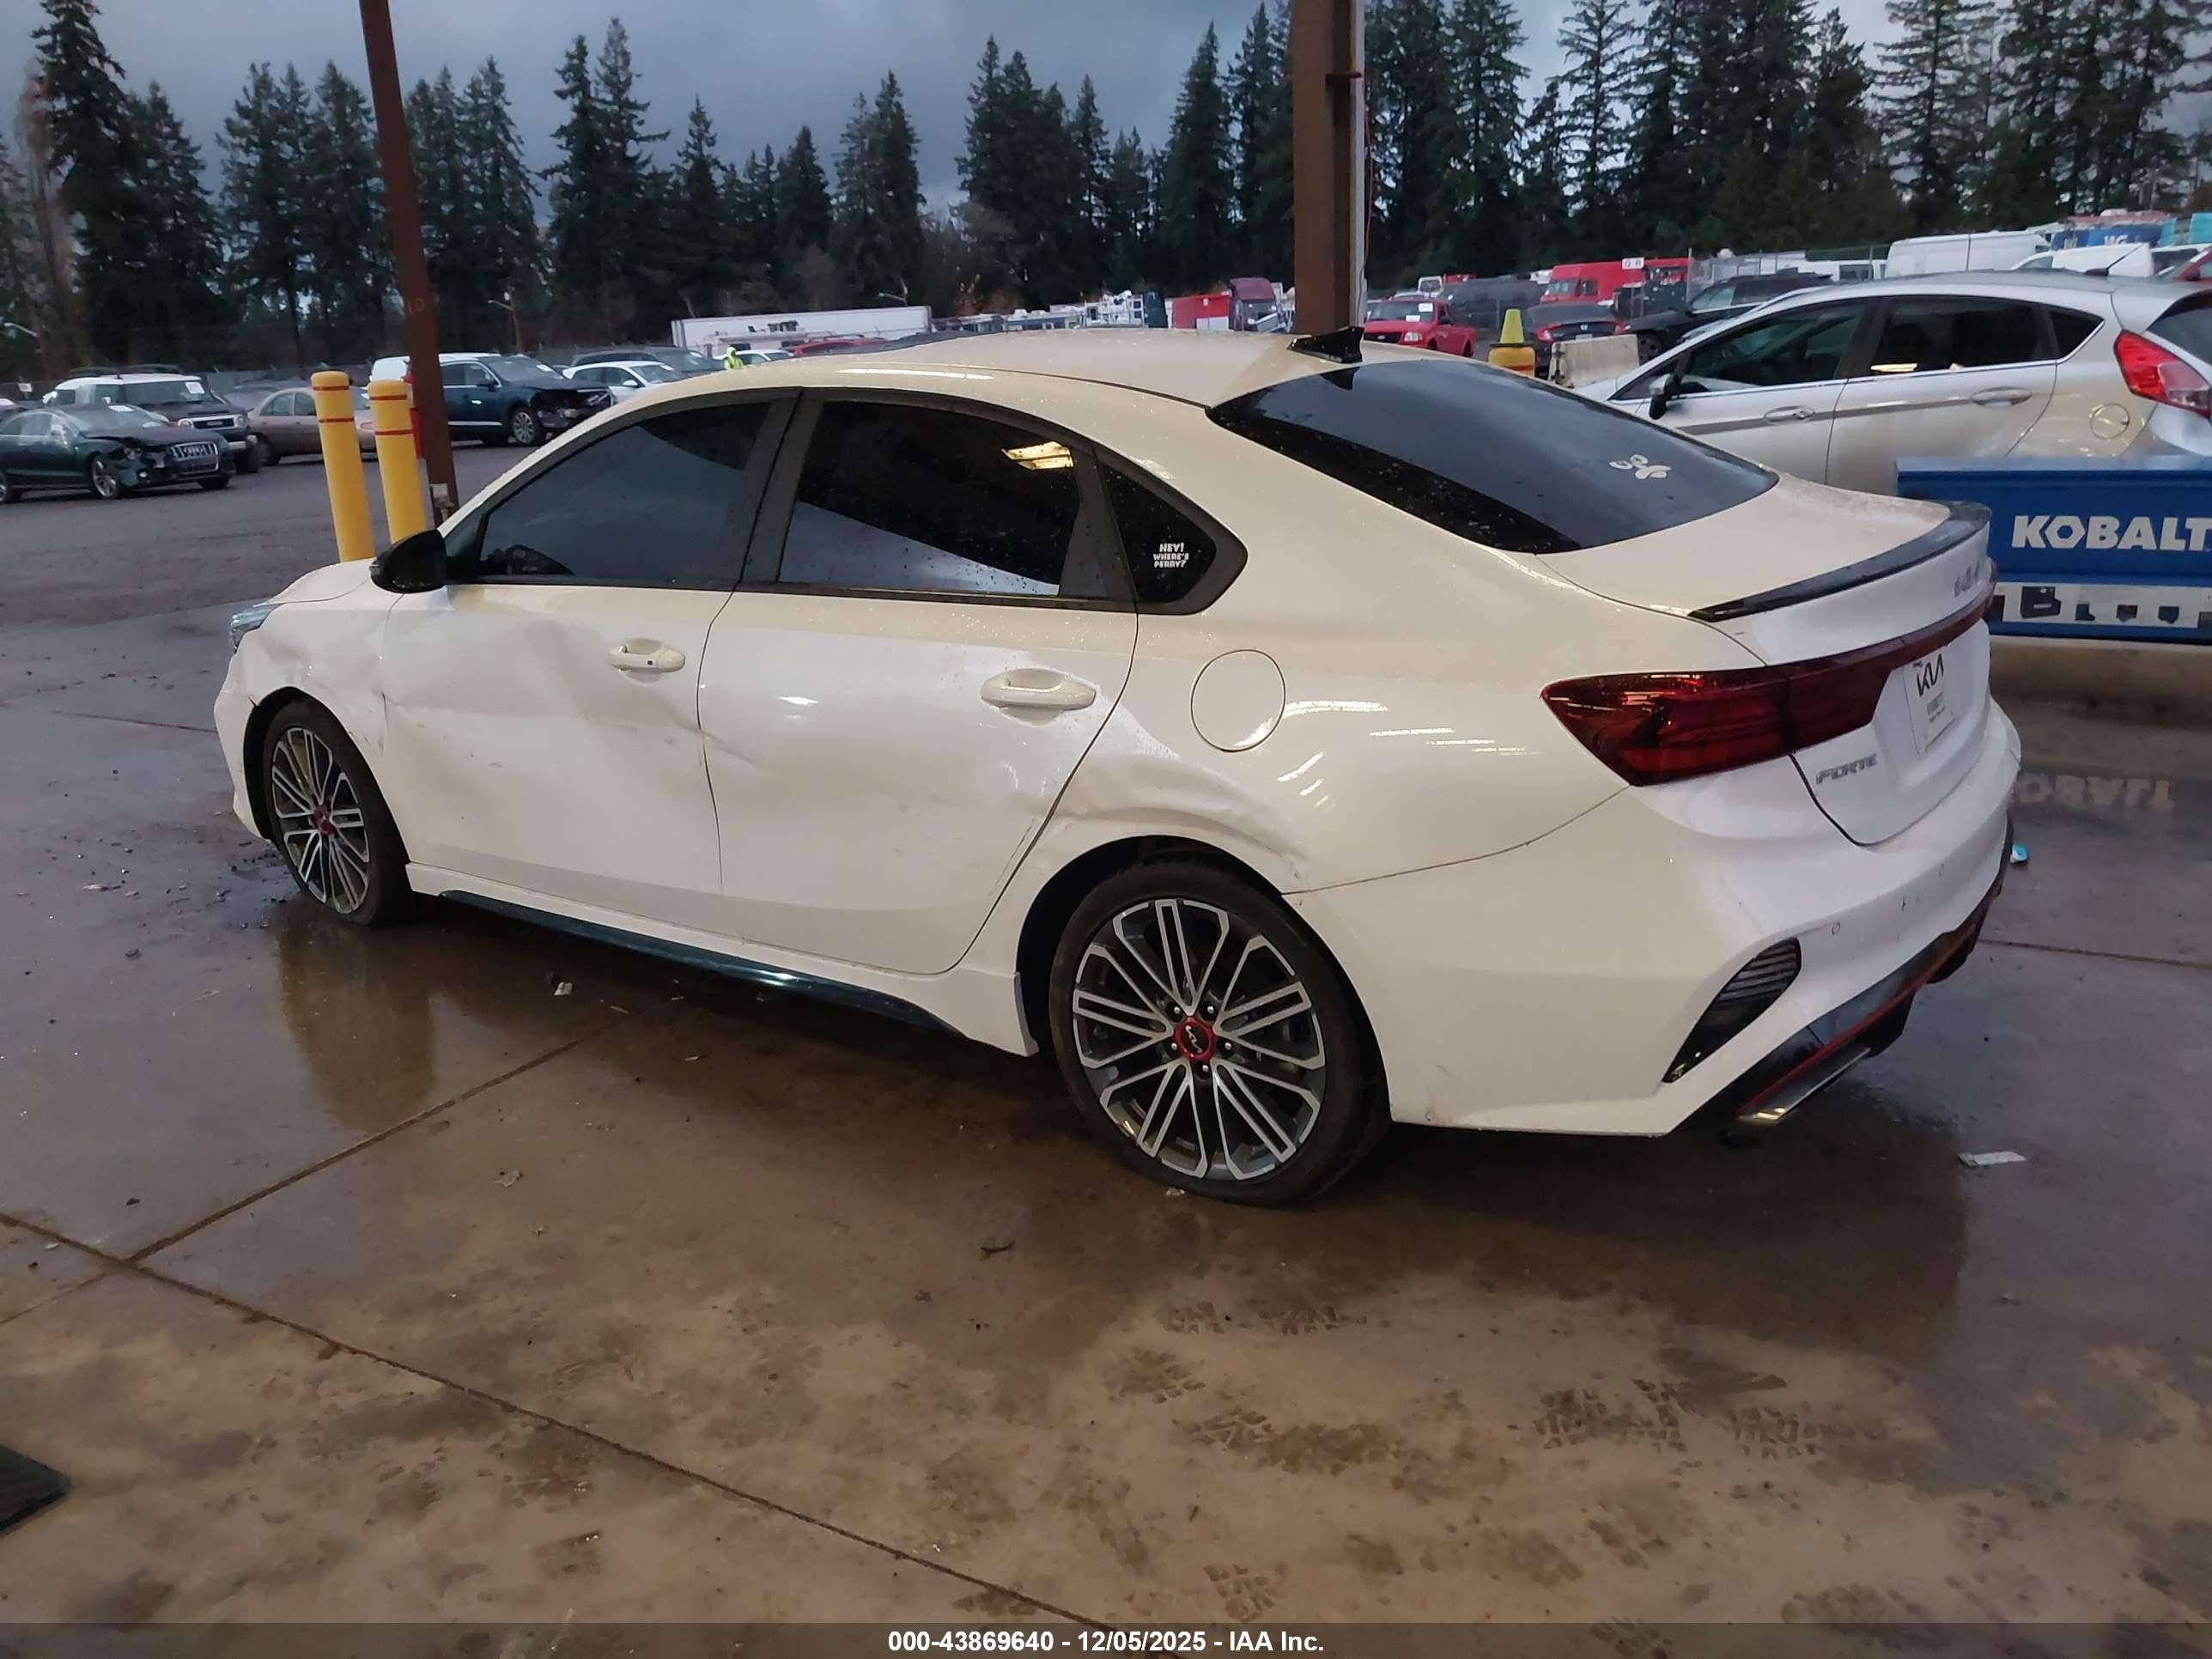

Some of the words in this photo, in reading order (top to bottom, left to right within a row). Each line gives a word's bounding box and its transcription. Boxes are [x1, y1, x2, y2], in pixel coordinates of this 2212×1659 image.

[2011, 514, 2212, 551] KOBALT
[1158, 542, 1185, 552] HEY!
[1153, 560, 1187, 568] PERRY?
[1815, 752, 1878, 784] FORTE
